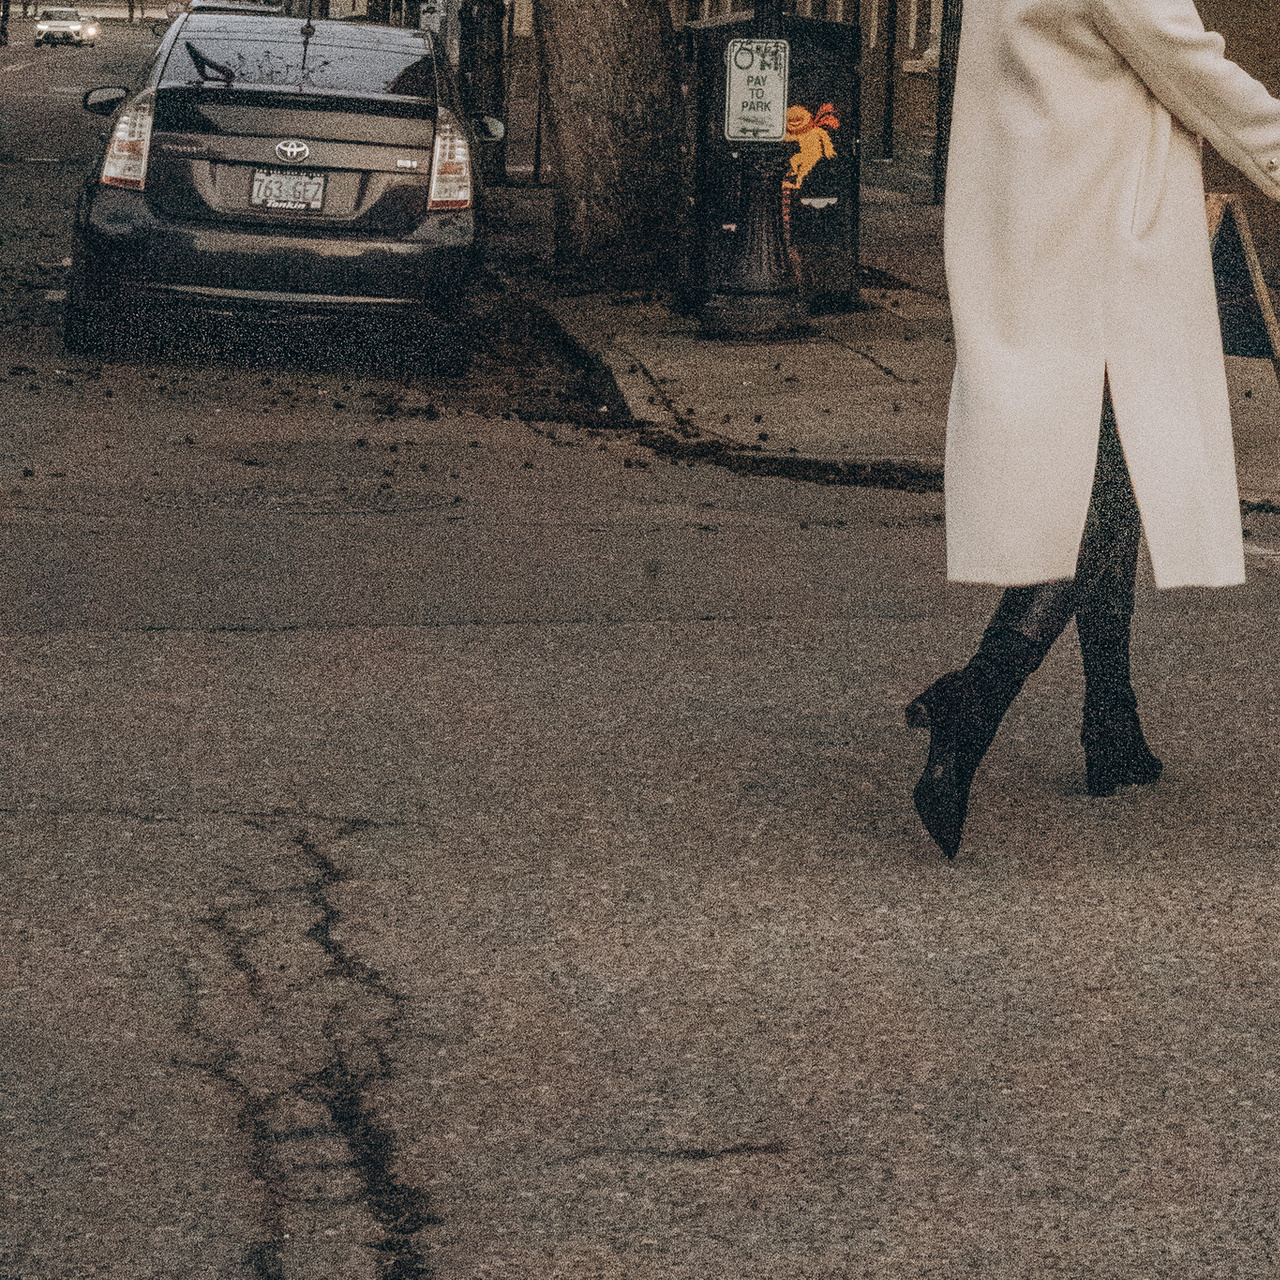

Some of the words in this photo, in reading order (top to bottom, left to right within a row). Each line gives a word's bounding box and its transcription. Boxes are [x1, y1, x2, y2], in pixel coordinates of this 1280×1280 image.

[747, 75, 767, 86] PAY
[749, 88, 764, 99] TO
[741, 101, 771, 111] PARK
[254, 178, 283, 199] 763
